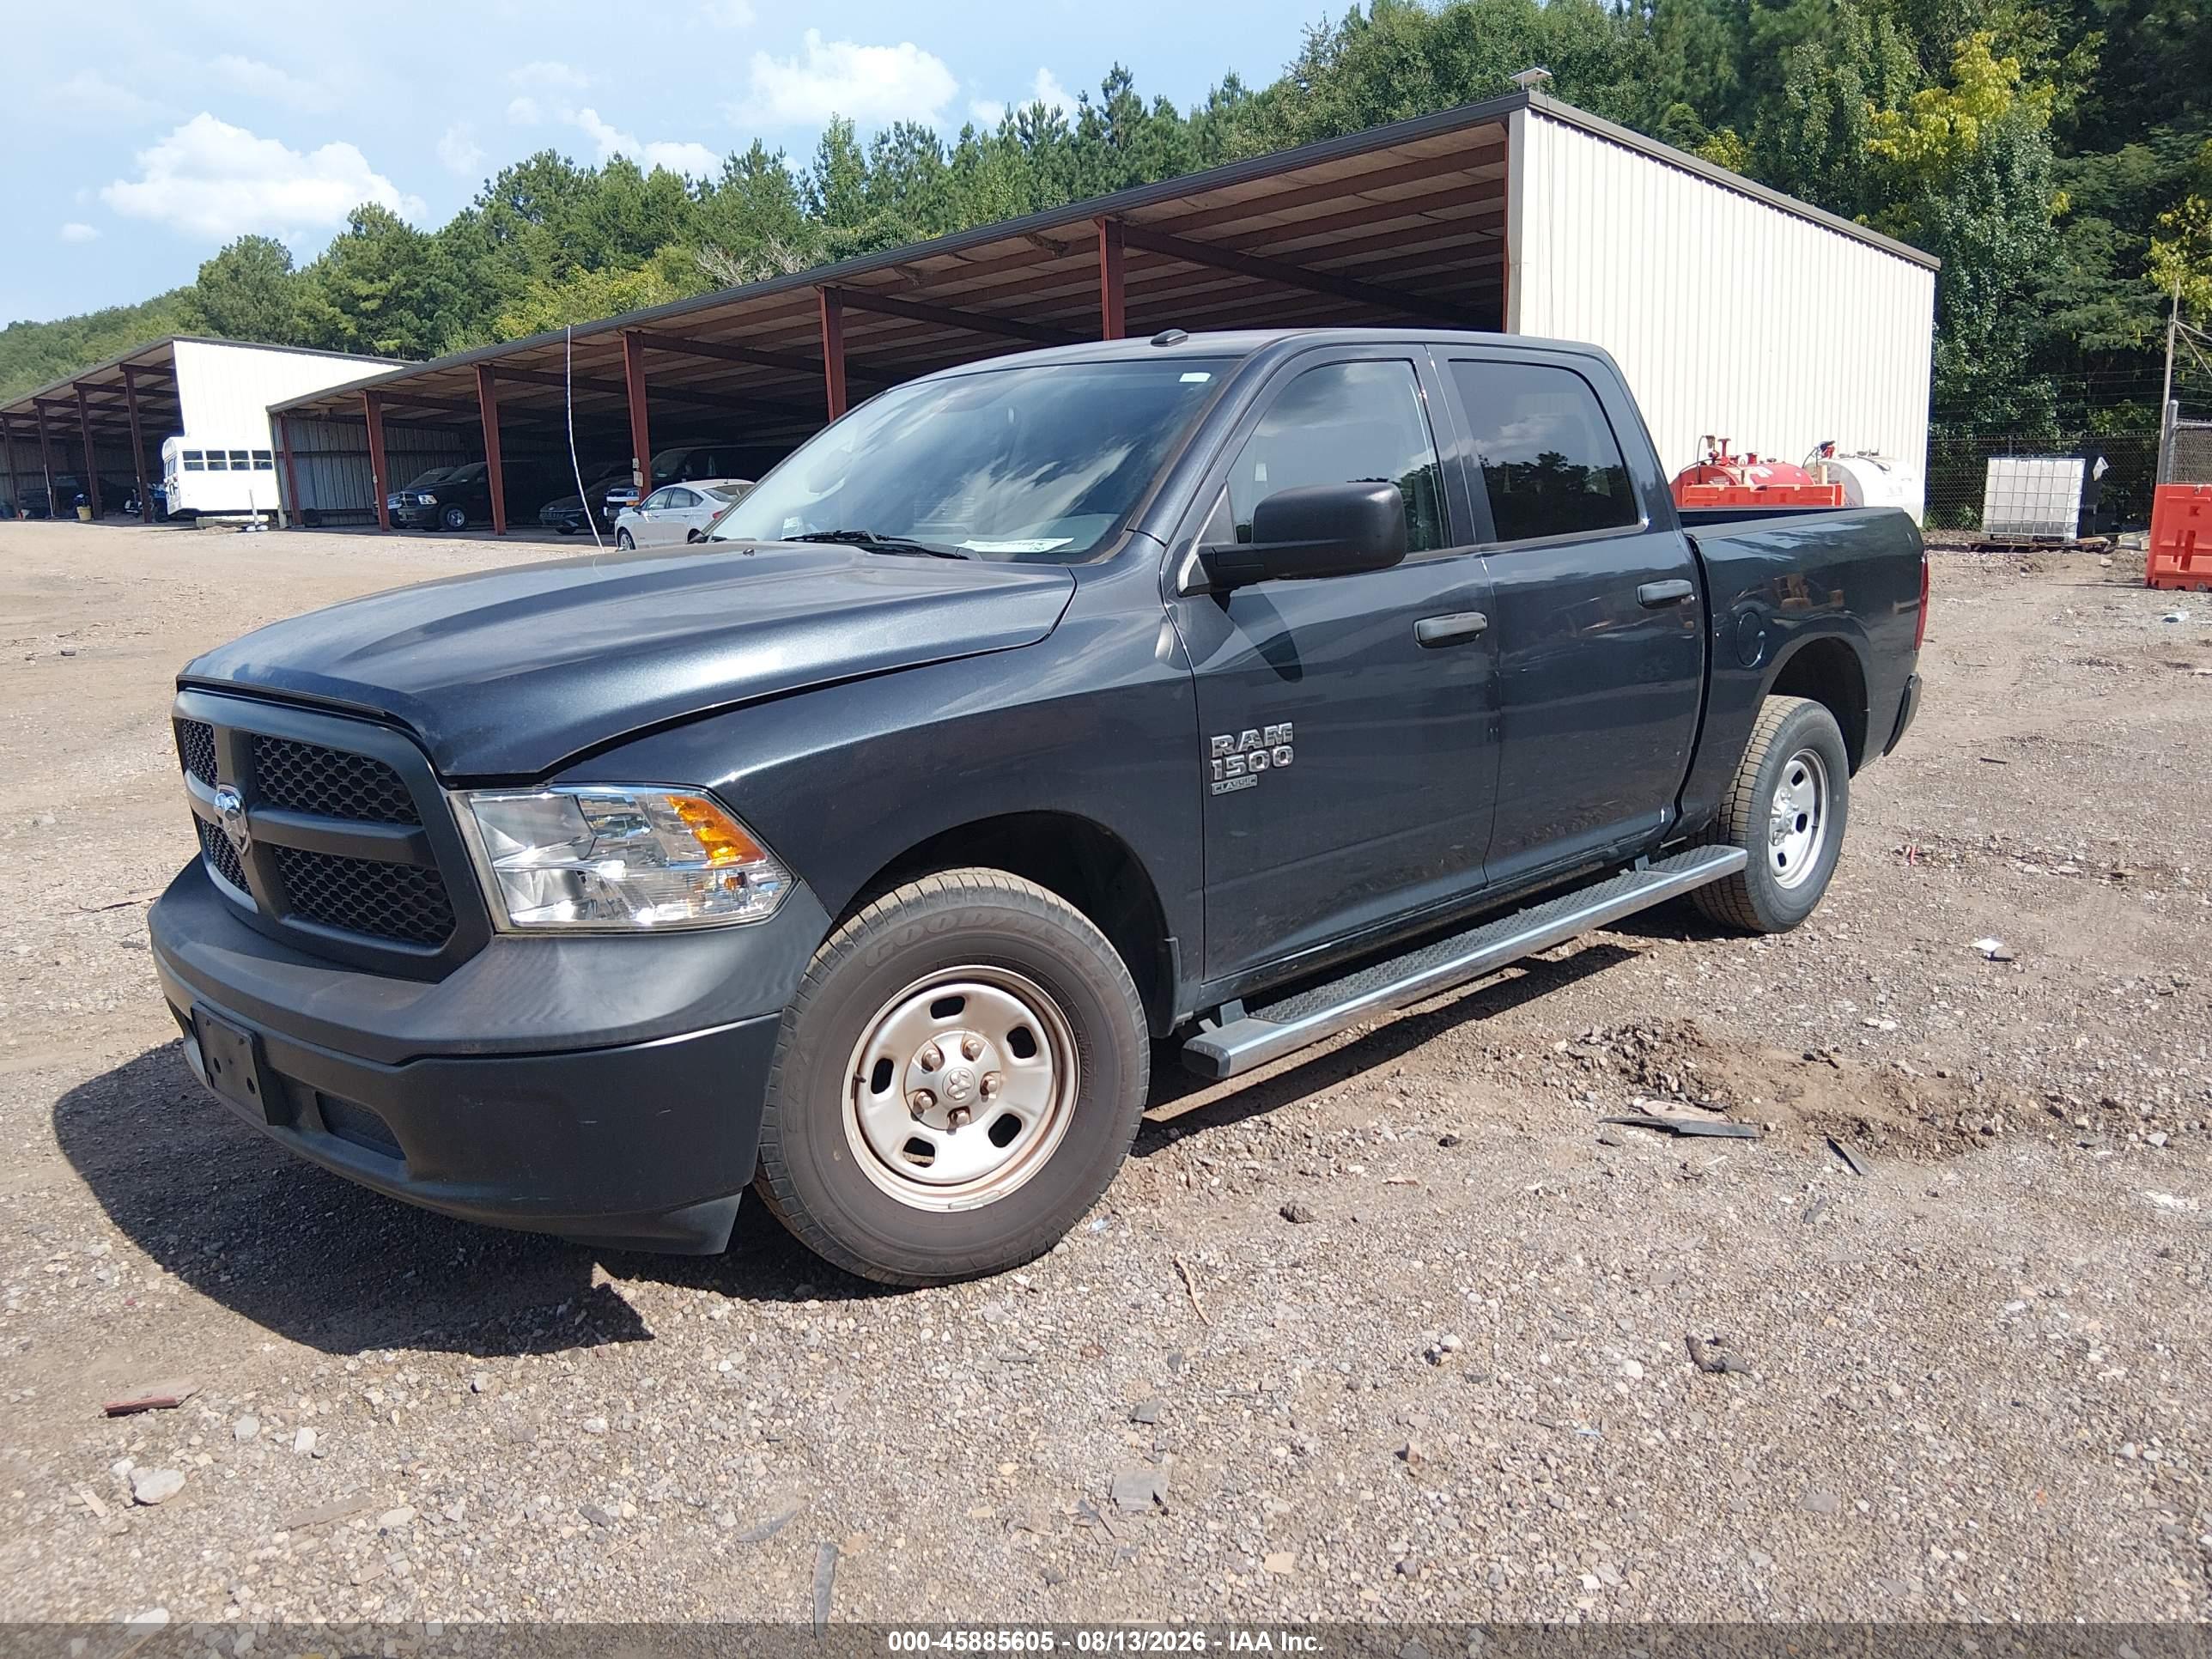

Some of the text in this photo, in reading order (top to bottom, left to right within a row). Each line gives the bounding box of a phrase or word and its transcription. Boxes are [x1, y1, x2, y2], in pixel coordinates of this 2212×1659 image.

[1210, 722, 1293, 757] RAM
[1211, 745, 1294, 781] 1500
[1212, 775, 1257, 794] CLASSIC
